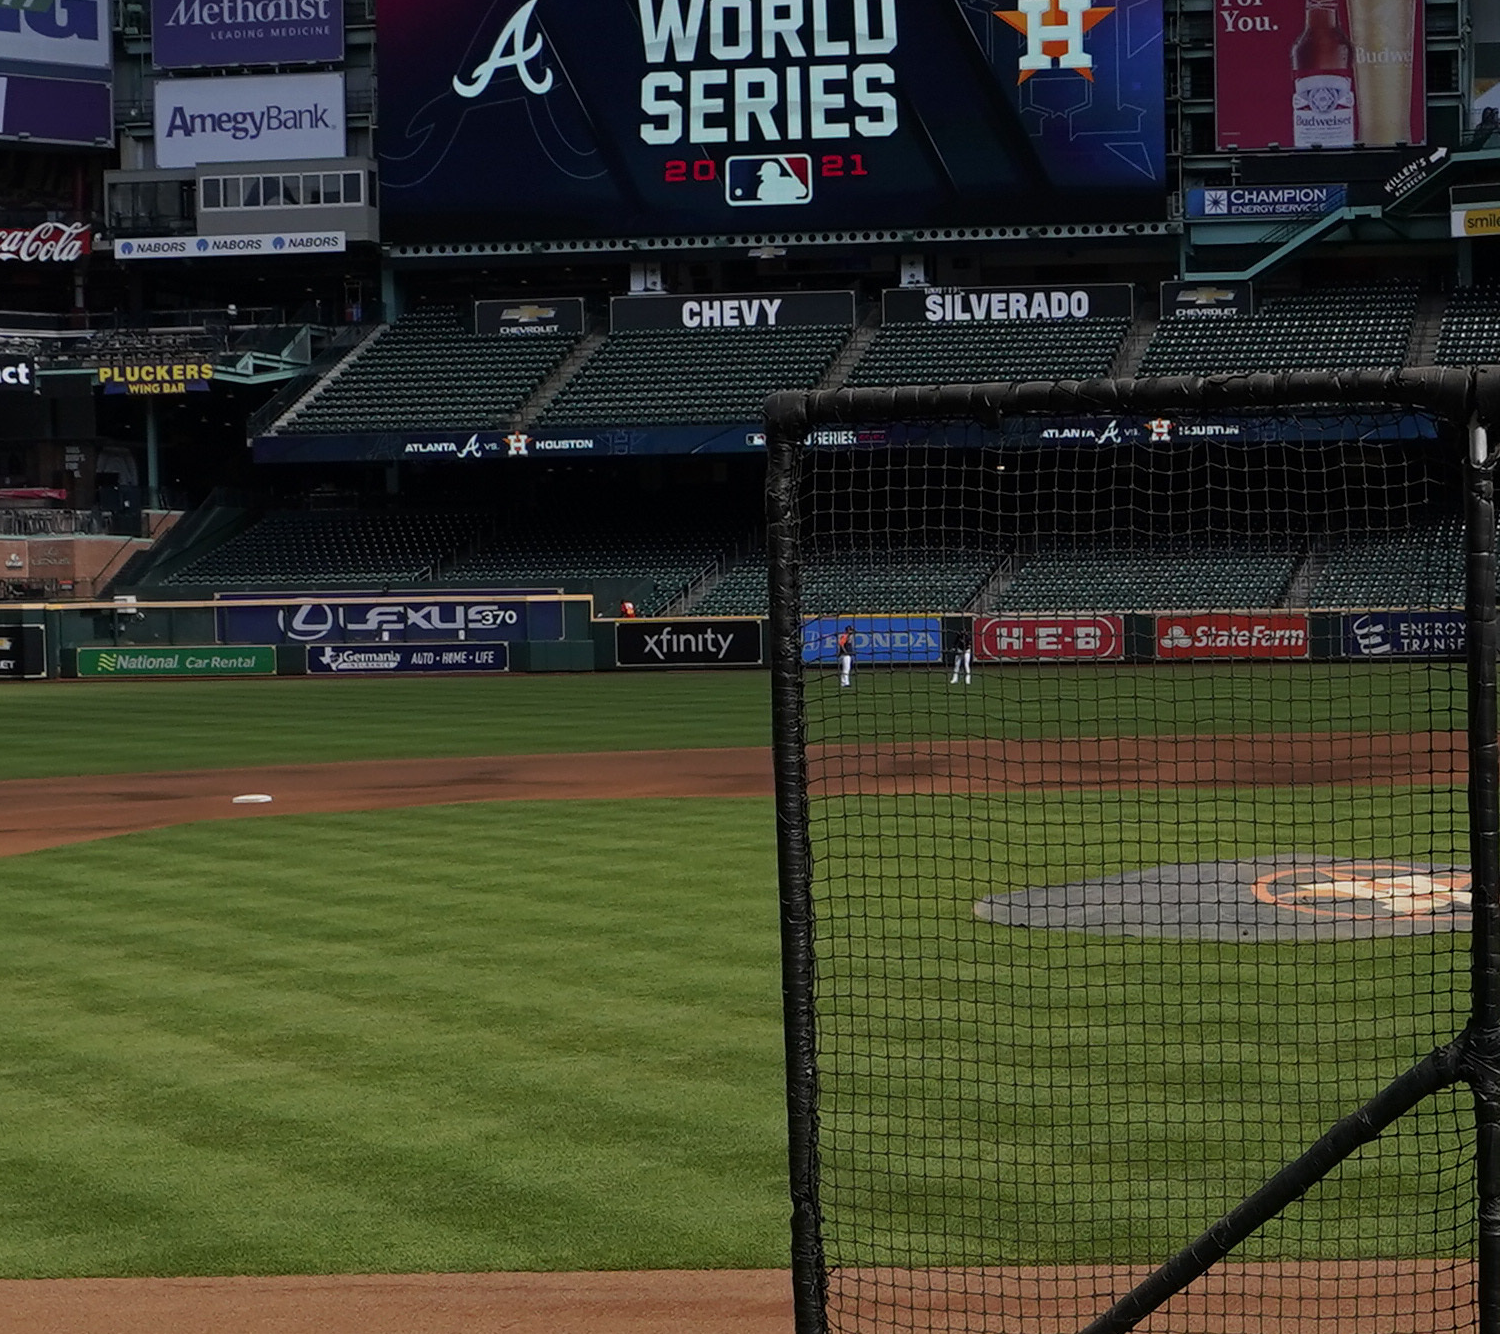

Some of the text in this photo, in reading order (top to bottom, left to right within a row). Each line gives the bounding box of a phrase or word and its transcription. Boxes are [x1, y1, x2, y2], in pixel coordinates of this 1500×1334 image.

[1220, 10, 1279, 33] You.
[211, 25, 331, 40] LEADING MEDICINE
[639, 62, 899, 145] SERIES
[165, 103, 329, 140] AmegyBank
[665, 154, 868, 182] 20 21
[1383, 156, 1427, 194] KILLEN'S
[1231, 188, 1327, 204] CHAMPION
[1231, 204, 1274, 214] ENERGY
[136, 242, 187, 254] NABORS
[212, 239, 262, 251] NABORS
[288, 236, 339, 249] NABORS
[682, 298, 782, 329] CHEVY
[925, 290, 1090, 322] SILVERADO
[1176, 308, 1237, 316] CHEVROLET
[500, 325, 559, 335] CHEVROLET
[99, 364, 214, 383] PLUCKERS
[128, 382, 186, 394] WING BAR
[404, 439, 593, 453] ATLANTA VS. HOUSTON
[339, 605, 499, 630] LEXUS
[482, 610, 517, 625] 370
[1400, 622, 1467, 636] ENERGY
[643, 627, 734, 660] xfinity
[996, 626, 1101, 650] H-E-B
[1400, 637, 1466, 652] TRANSF
[117, 654, 256, 670] National Car Rental
[343, 650, 401, 663] Germania
[411, 650, 495, 664] AUTO HOME LIFE
